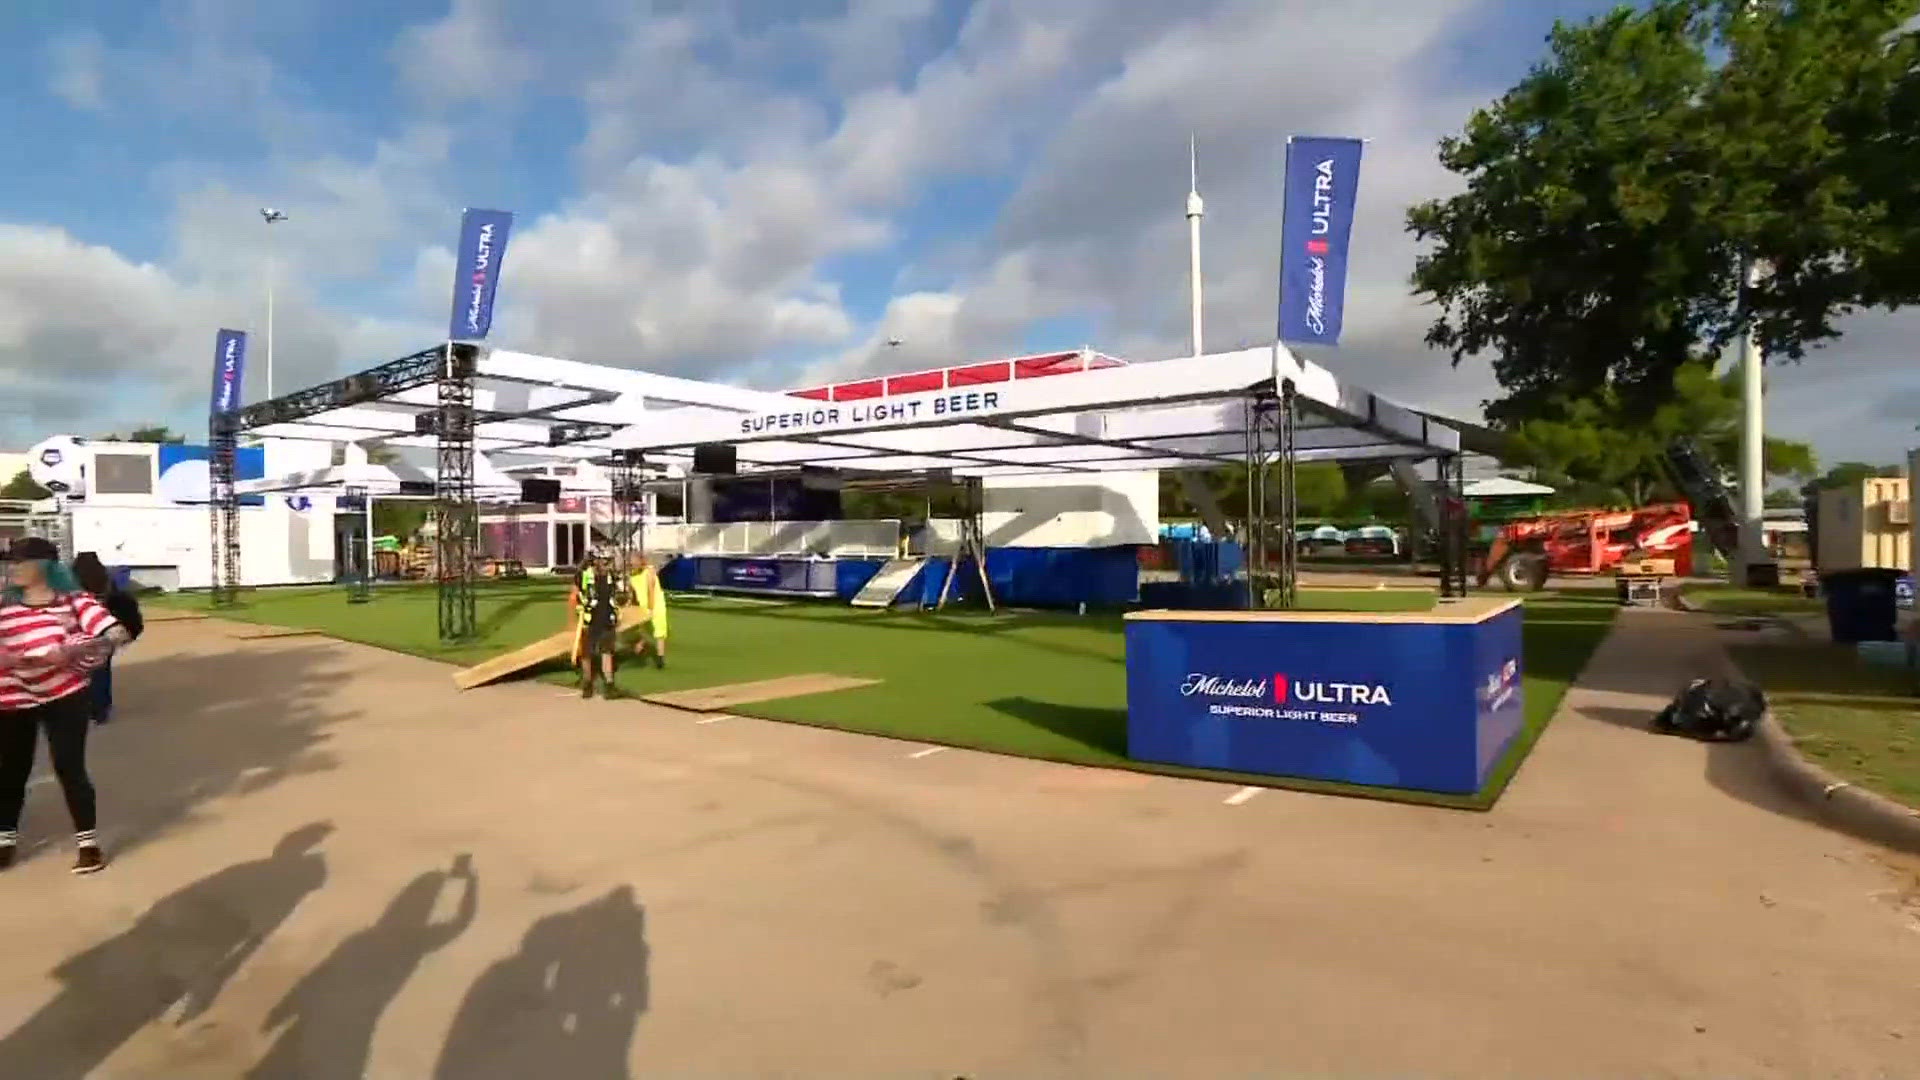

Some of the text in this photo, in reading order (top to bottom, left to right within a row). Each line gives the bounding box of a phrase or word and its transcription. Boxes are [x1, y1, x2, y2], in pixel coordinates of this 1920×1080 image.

[1312, 159, 1334, 235] ULTRA
[475, 223, 496, 270] ULTRA
[741, 392, 999, 433] SUPERIOR LIGHT BEER
[1181, 673, 1392, 706] Michelob ULTRA
[1210, 705, 1358, 724] SUPERIOR LIGHT BEER
